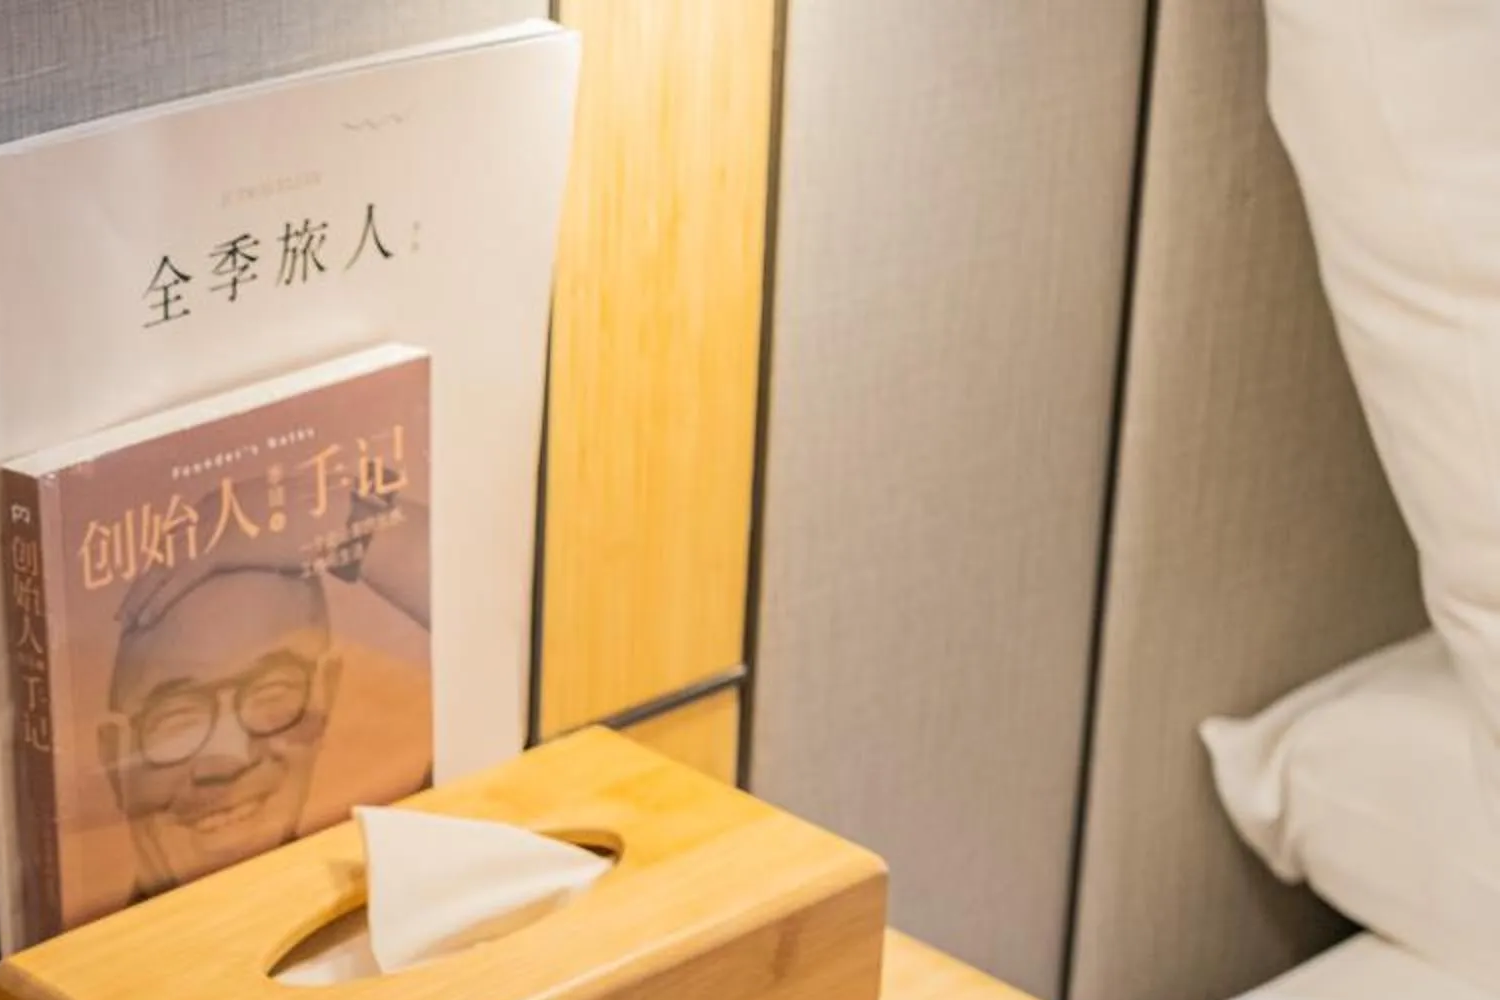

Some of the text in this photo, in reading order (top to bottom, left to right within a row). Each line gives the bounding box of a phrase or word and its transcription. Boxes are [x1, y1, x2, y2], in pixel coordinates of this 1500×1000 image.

[142, 202, 394, 328] 全季旅人
[78, 476, 260, 591] 创始人
[296, 424, 409, 519] 手记
